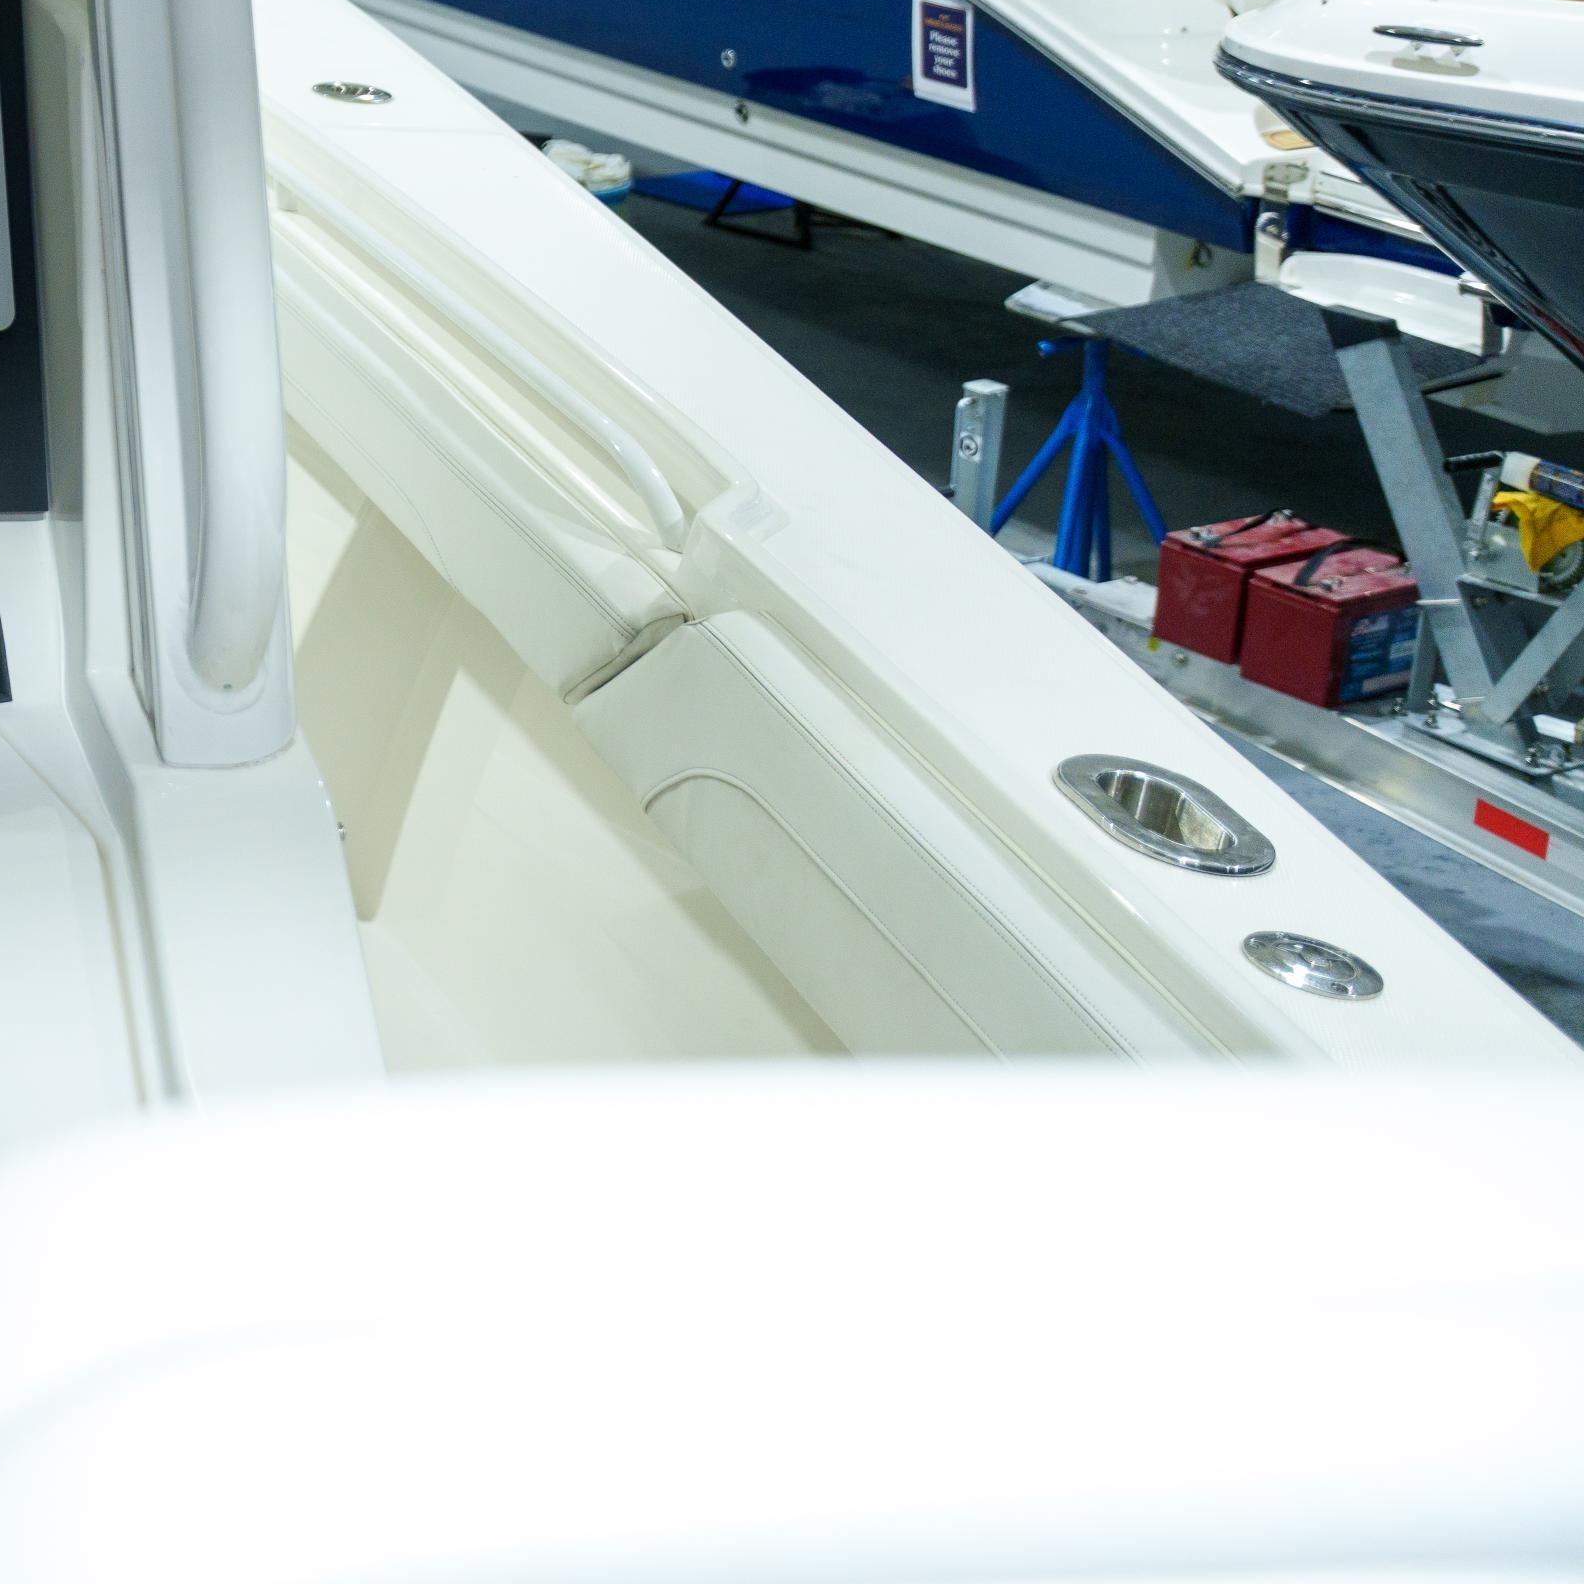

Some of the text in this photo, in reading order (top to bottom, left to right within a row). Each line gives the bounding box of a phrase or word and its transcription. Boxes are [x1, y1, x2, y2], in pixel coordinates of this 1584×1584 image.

[929, 29, 959, 46] Please
[928, 43, 961, 57] remove
[934, 54, 955, 67] your
[933, 65, 959, 78] shoes
